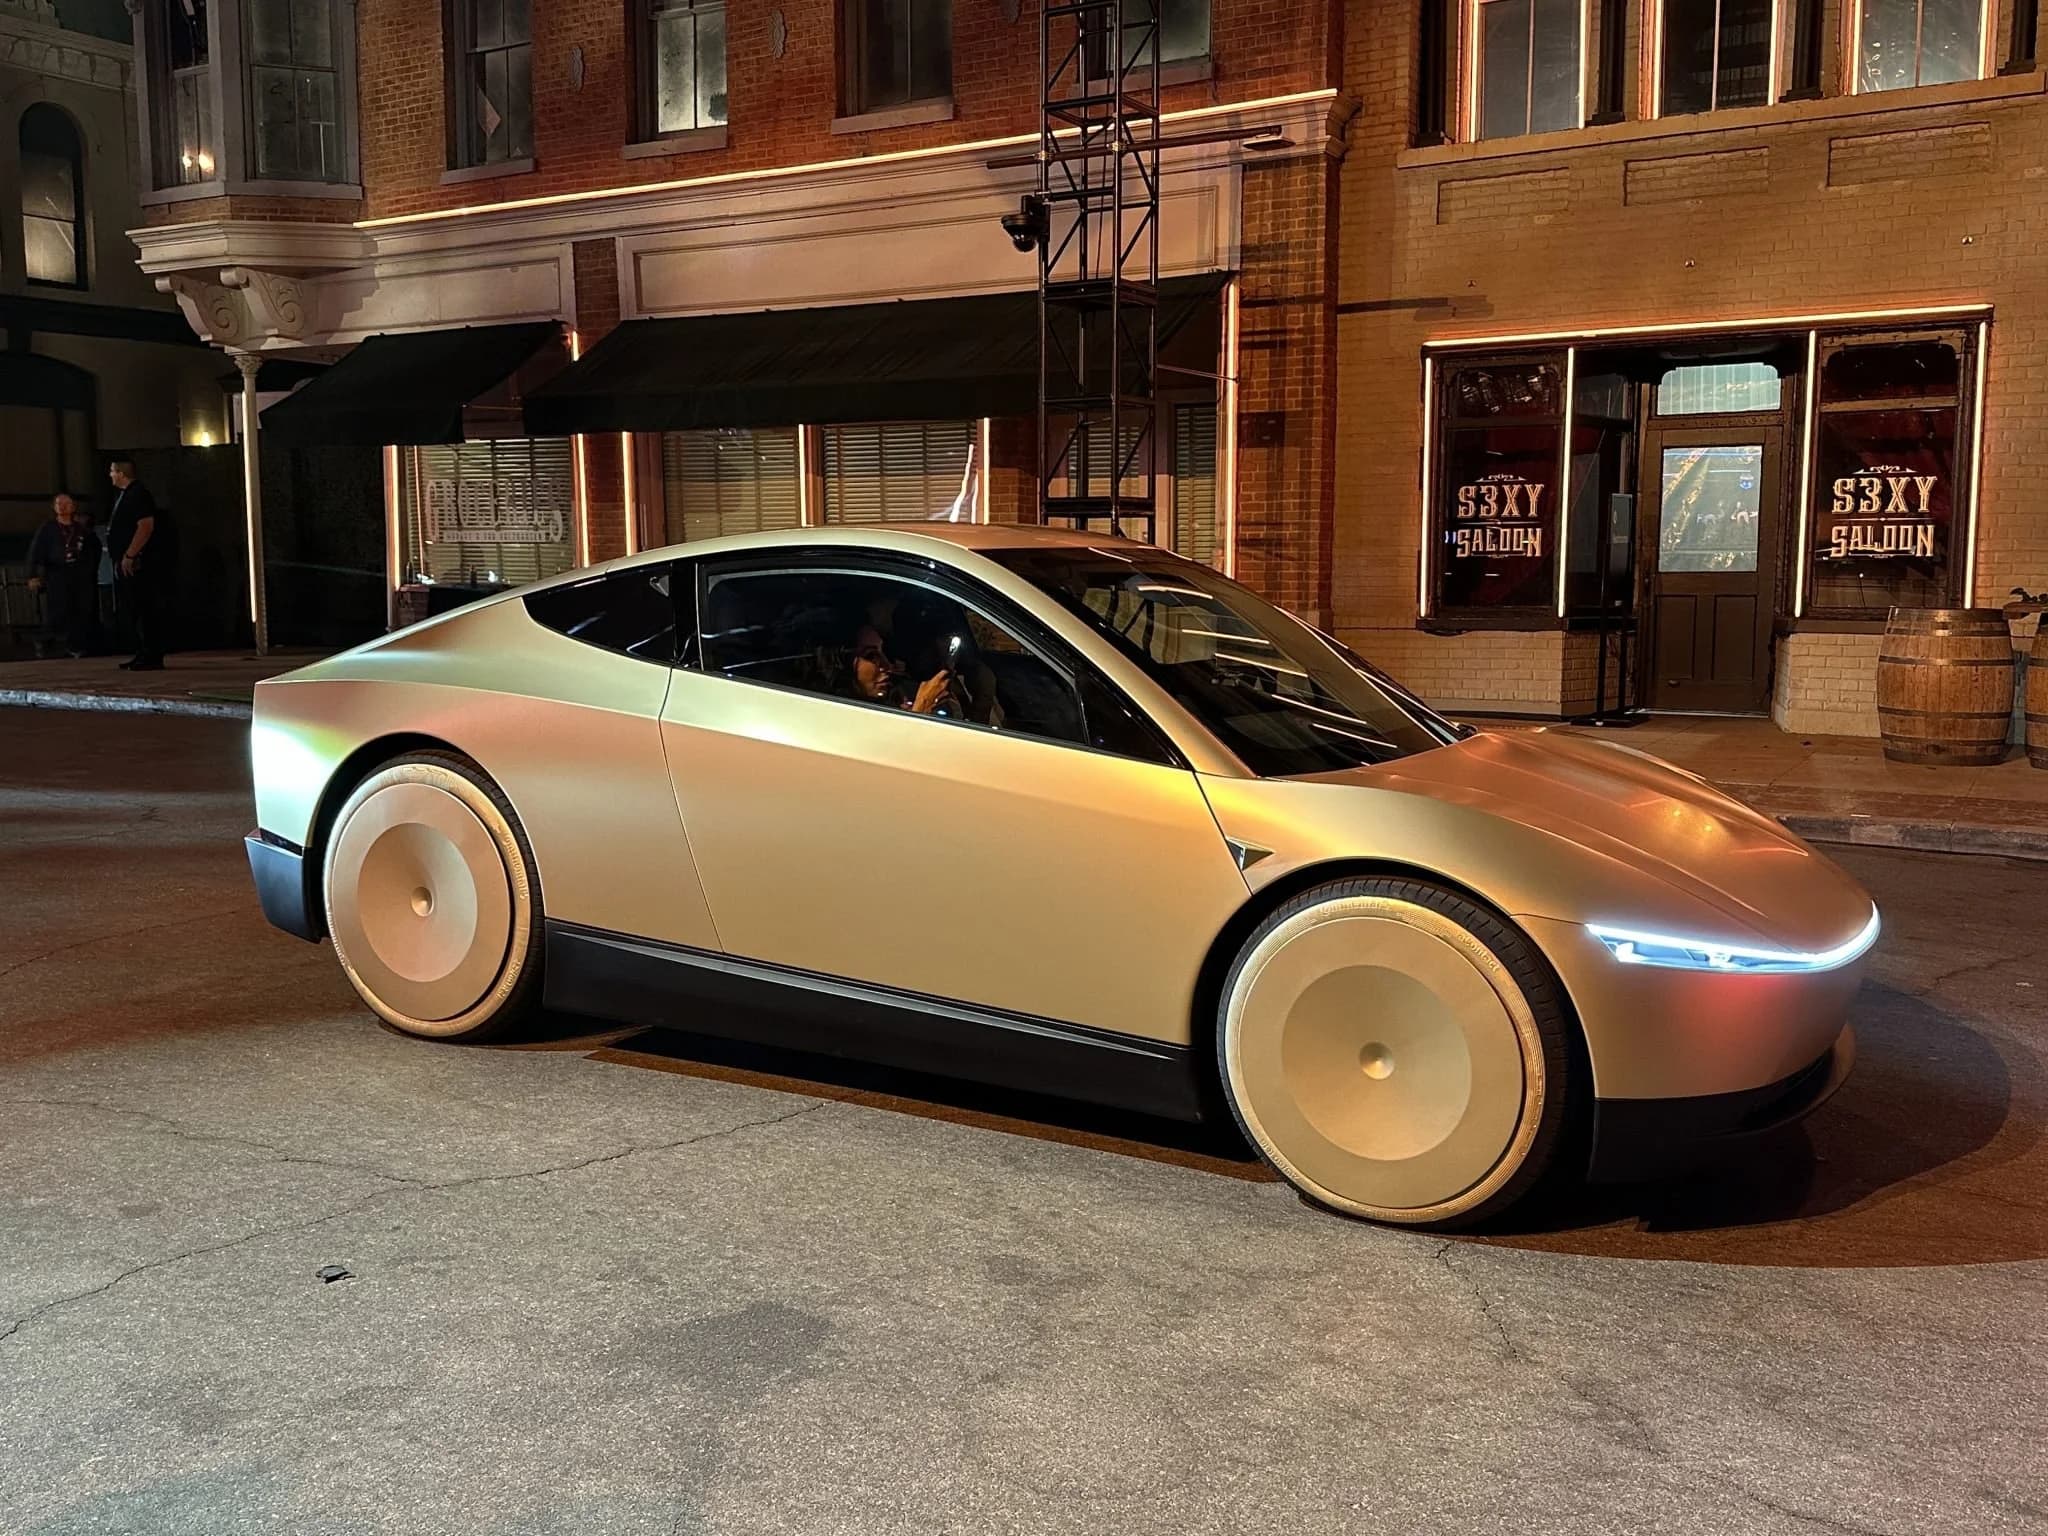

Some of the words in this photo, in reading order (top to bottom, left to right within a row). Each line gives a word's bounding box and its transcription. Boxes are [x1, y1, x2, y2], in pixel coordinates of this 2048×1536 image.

[1457, 484, 1545, 518] S3XY
[1832, 475, 1938, 515] S3XY
[1456, 527, 1543, 558] SALOON
[1830, 524, 1935, 558] SALOON
